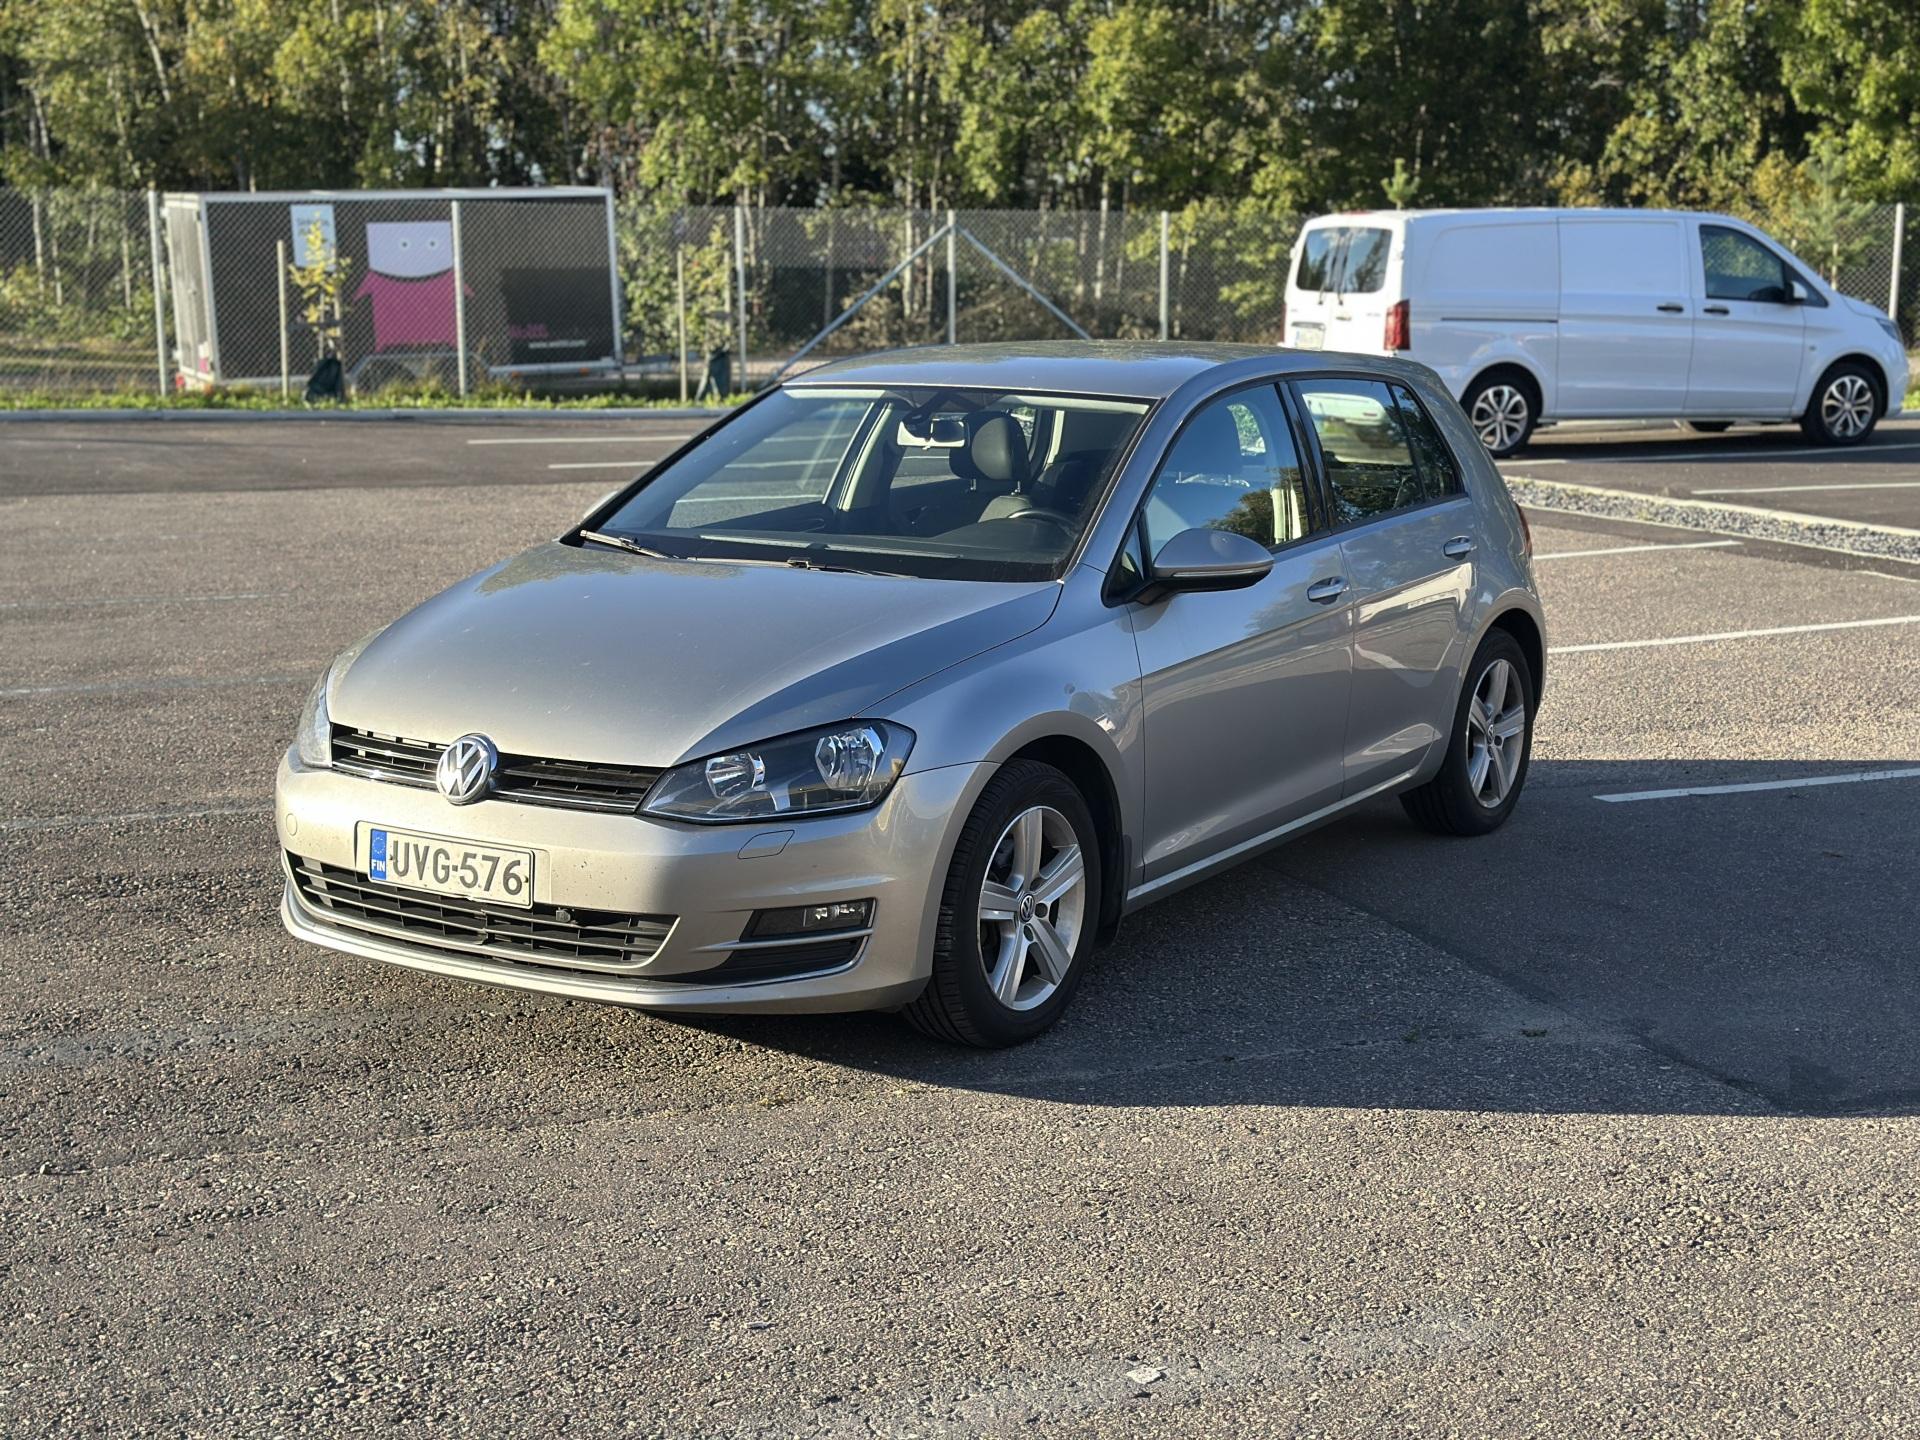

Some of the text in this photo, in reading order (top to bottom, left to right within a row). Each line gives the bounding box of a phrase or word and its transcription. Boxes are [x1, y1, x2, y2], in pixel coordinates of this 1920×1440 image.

[437, 736, 490, 801] VW
[371, 840, 523, 896] FIN UVG-576
